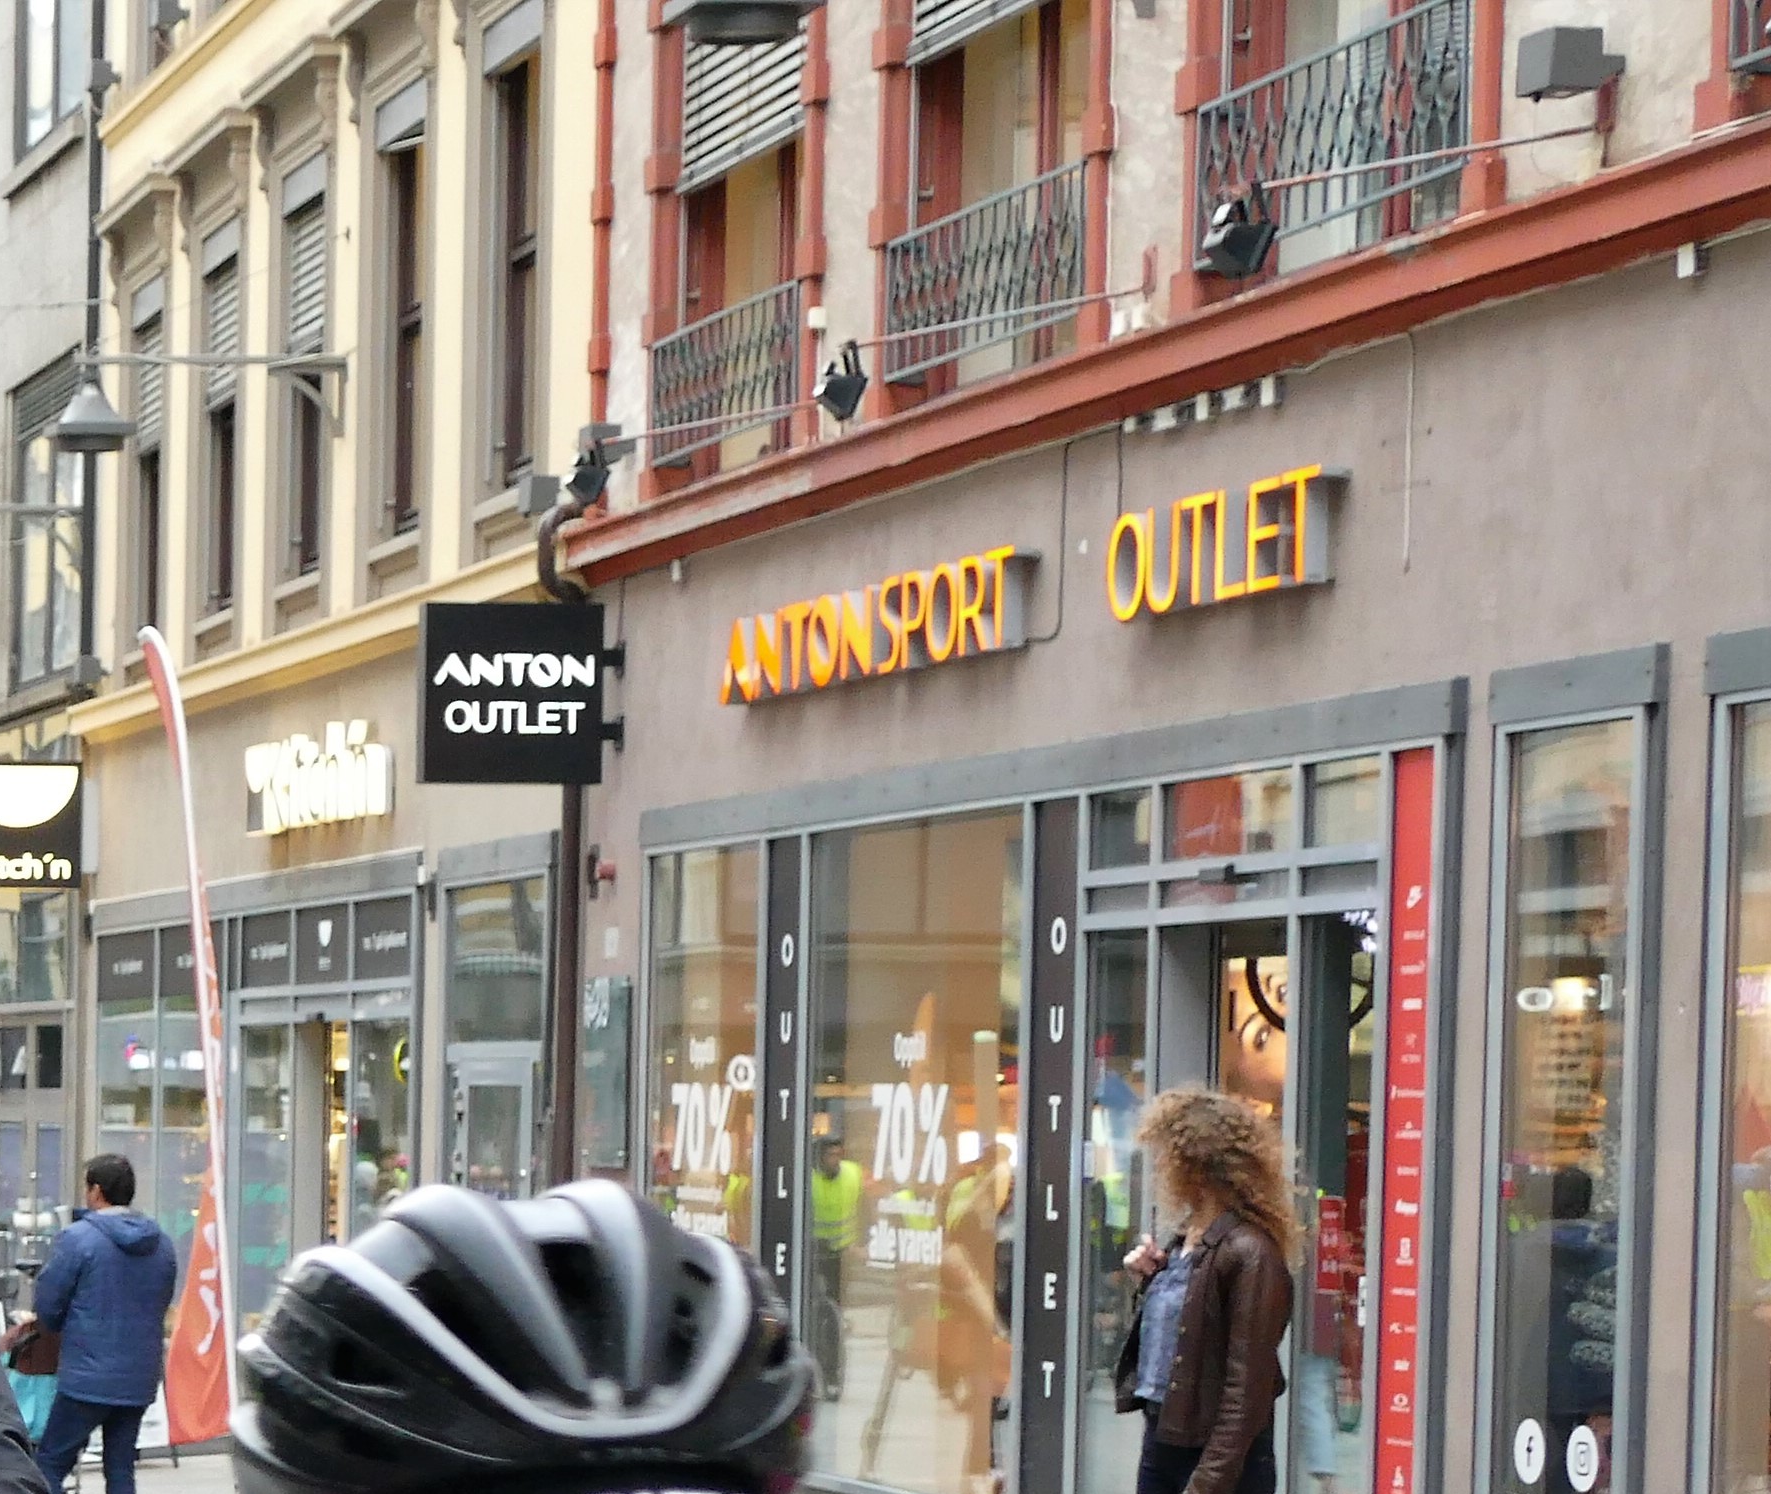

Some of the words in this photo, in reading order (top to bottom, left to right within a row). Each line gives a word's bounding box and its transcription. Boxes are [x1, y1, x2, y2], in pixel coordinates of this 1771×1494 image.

[1106, 463, 1322, 622] OUTLET
[433, 653, 596, 688] ANTON
[444, 700, 586, 735] OUTLET
[671, 1082, 733, 1175] 70%
[872, 1081, 949, 1186] 70%
[1042, 916, 1067, 1399] OUTLET
